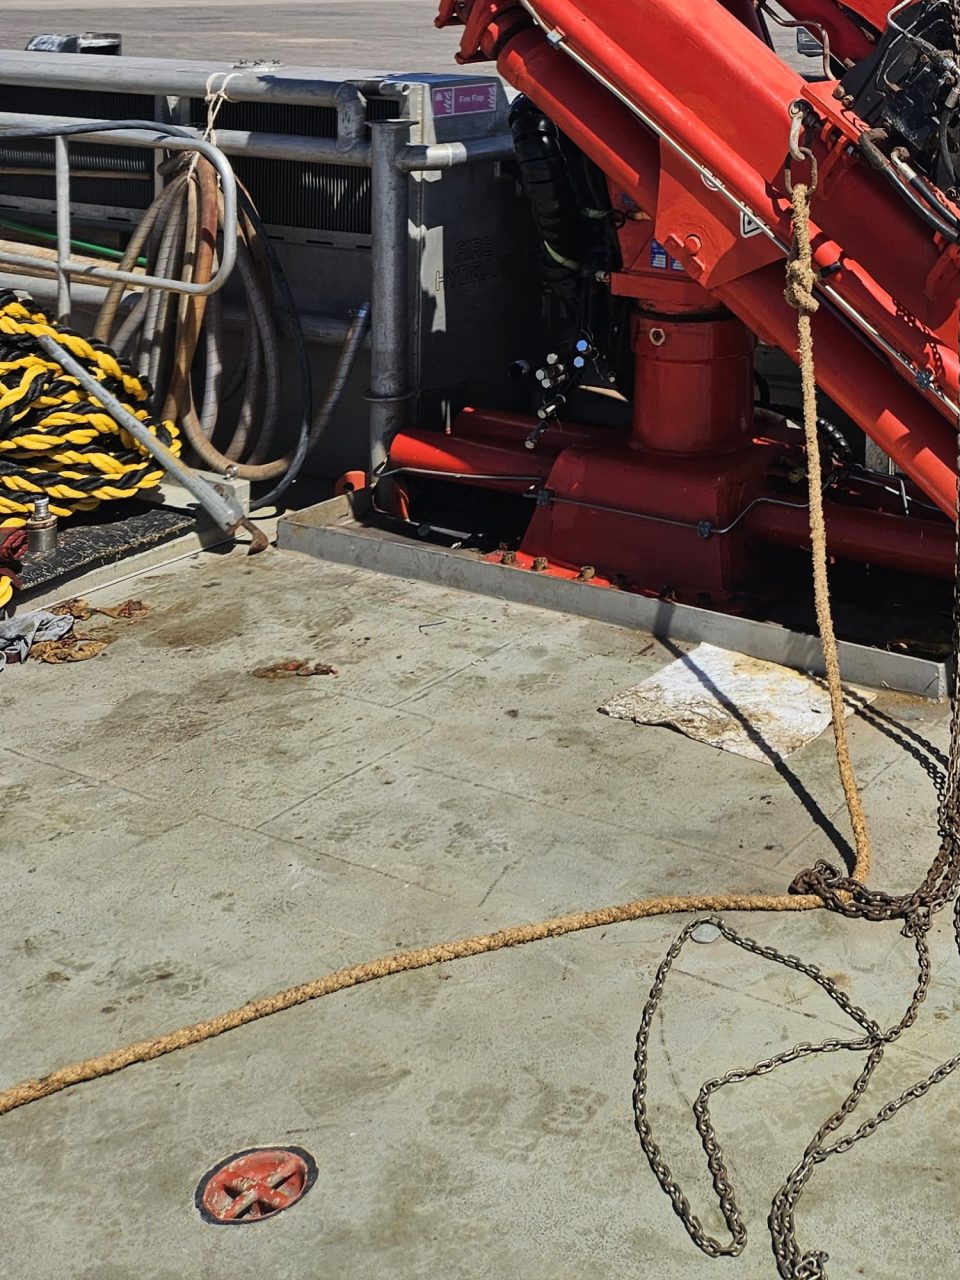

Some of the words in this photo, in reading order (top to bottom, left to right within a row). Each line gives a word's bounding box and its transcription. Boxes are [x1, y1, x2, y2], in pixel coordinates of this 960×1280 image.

[459, 95, 471, 104] Fire
[472, 94, 484, 103] Flap
[455, 235, 496, 262] FIRE
